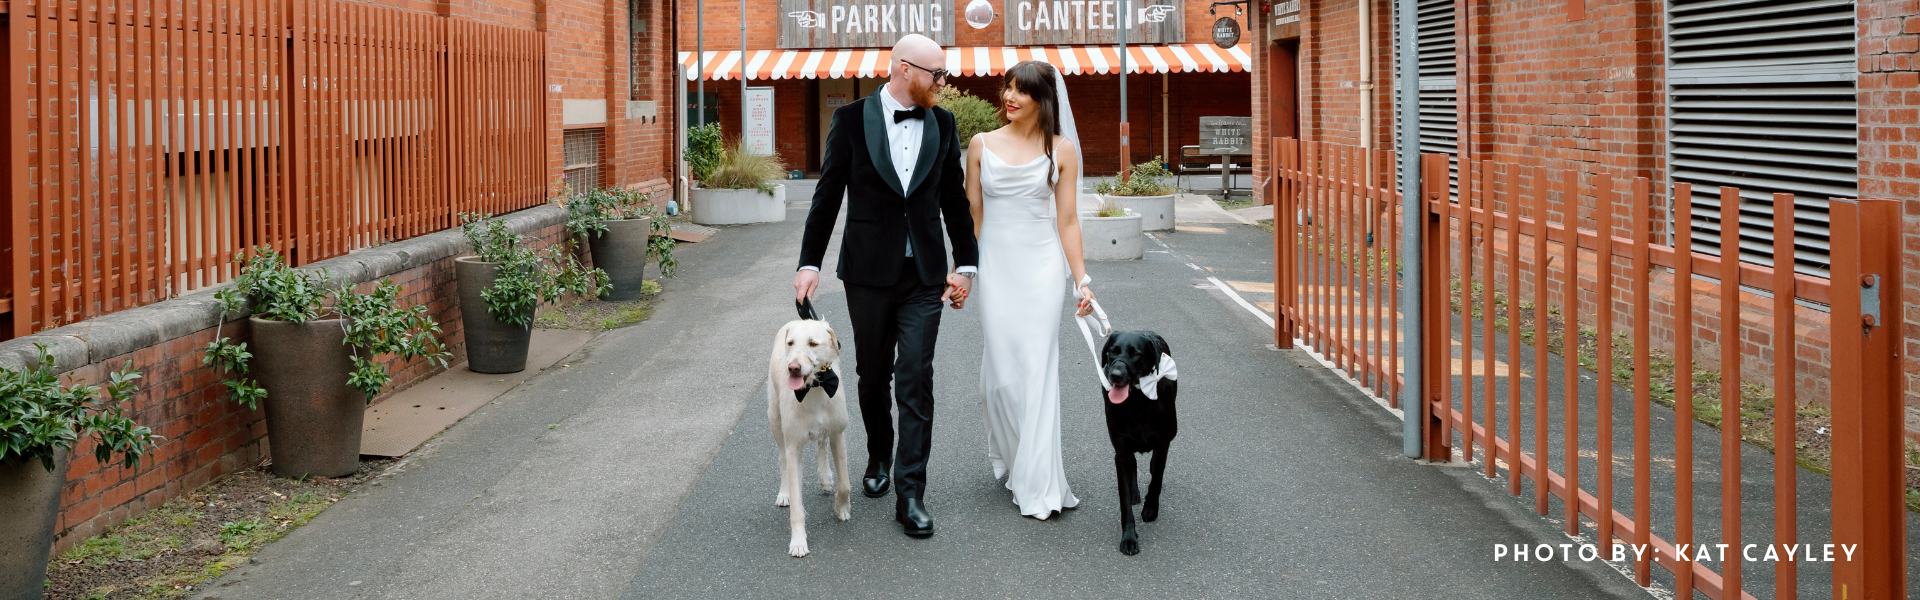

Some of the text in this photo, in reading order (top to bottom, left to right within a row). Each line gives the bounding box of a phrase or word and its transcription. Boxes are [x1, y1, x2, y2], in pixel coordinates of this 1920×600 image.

[831, 3, 942, 34] PARKING
[1017, 0, 1132, 31] CANTEEN
[1212, 137, 1244, 145] RABBIT
[1214, 128, 1241, 136] WHITE
